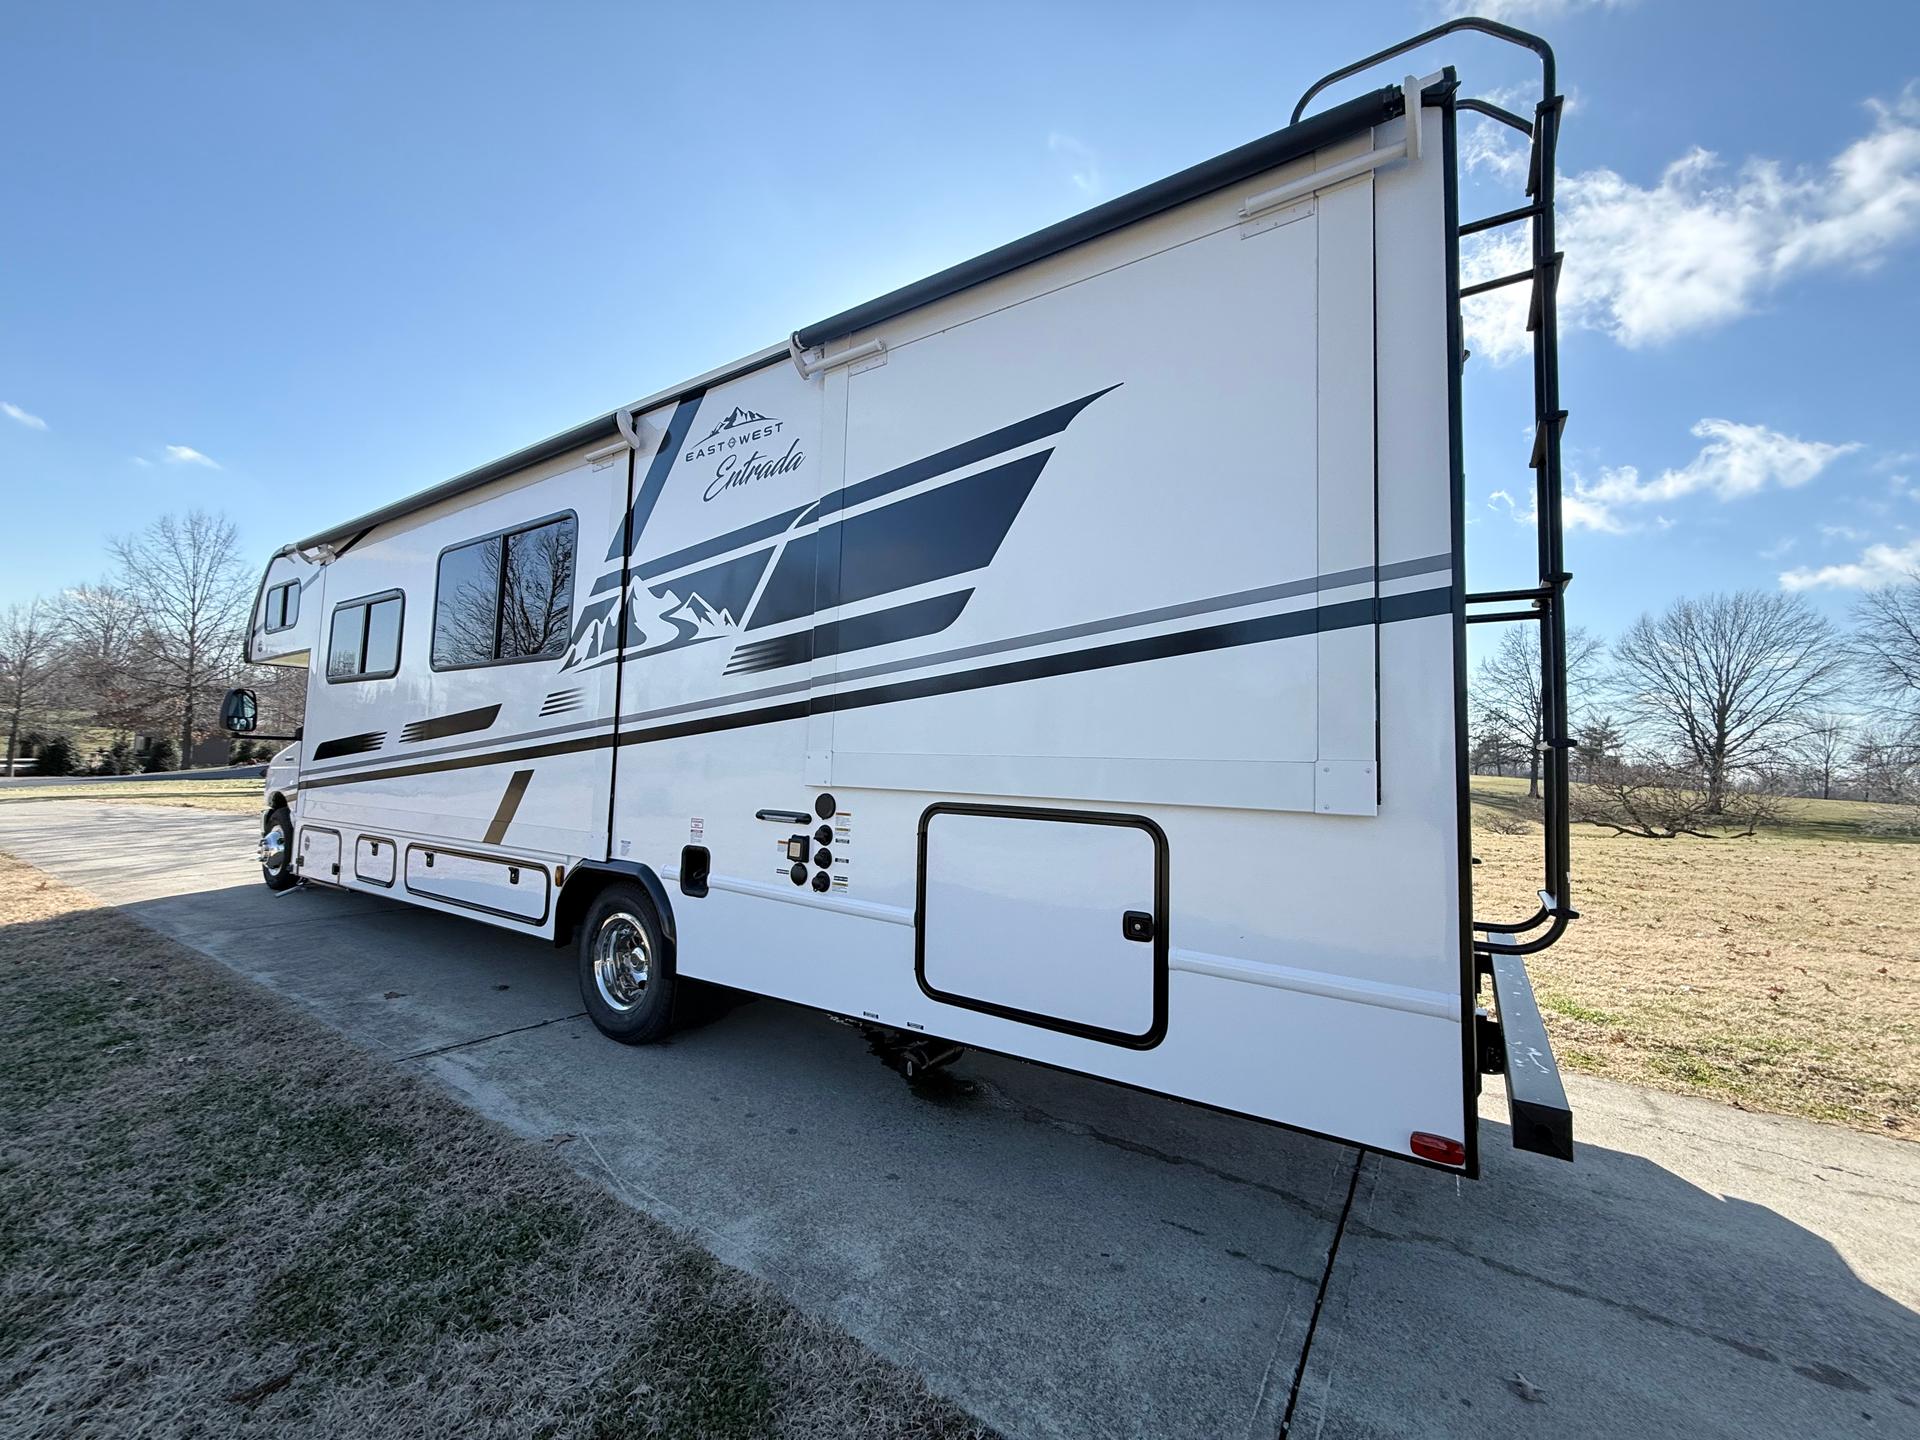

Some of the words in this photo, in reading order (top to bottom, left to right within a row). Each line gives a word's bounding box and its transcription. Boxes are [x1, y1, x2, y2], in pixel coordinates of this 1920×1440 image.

[685, 441, 725, 462] EAST
[739, 422, 784, 444] WEST
[703, 438, 806, 502] Entrada
